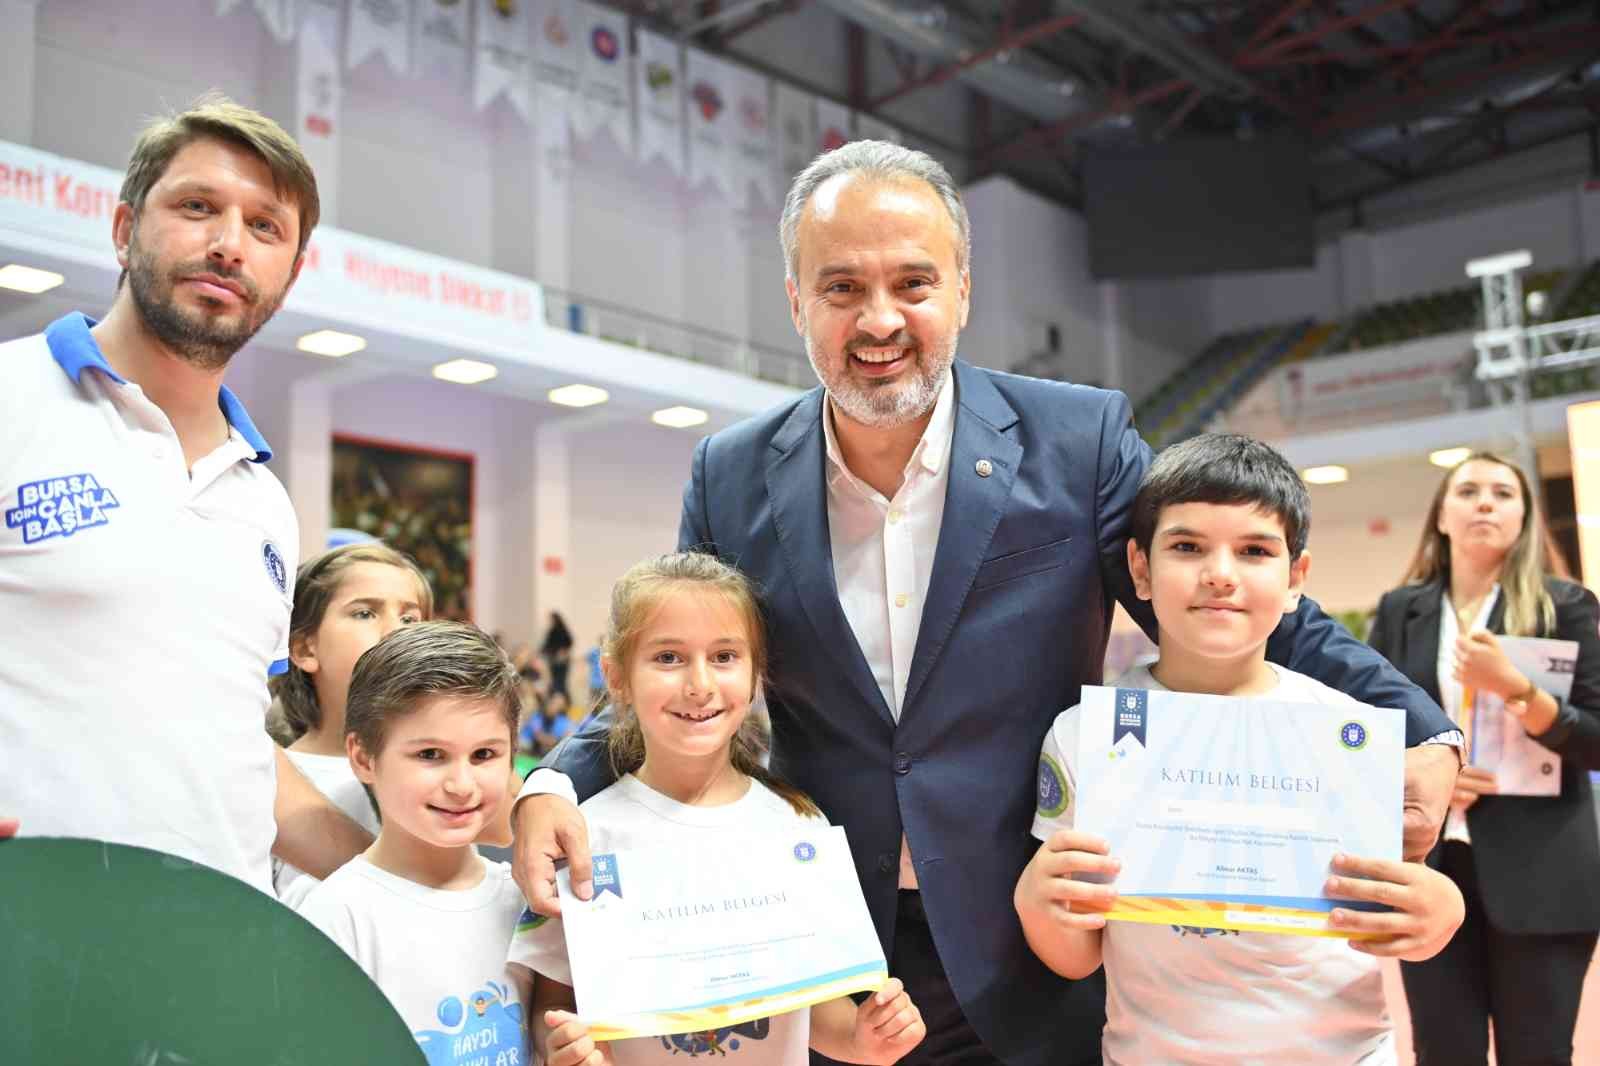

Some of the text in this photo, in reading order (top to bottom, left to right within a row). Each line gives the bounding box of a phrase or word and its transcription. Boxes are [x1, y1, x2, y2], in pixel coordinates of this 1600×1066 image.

[0, 161, 44, 207] eni
[22, 474, 98, 506] BURSA
[26, 507, 107, 540] BAŞLA
[1161, 767, 1320, 793] KATILIM BELGESİ
[641, 903, 715, 921] KATILIM
[454, 1023, 498, 1057] HAYDİ
